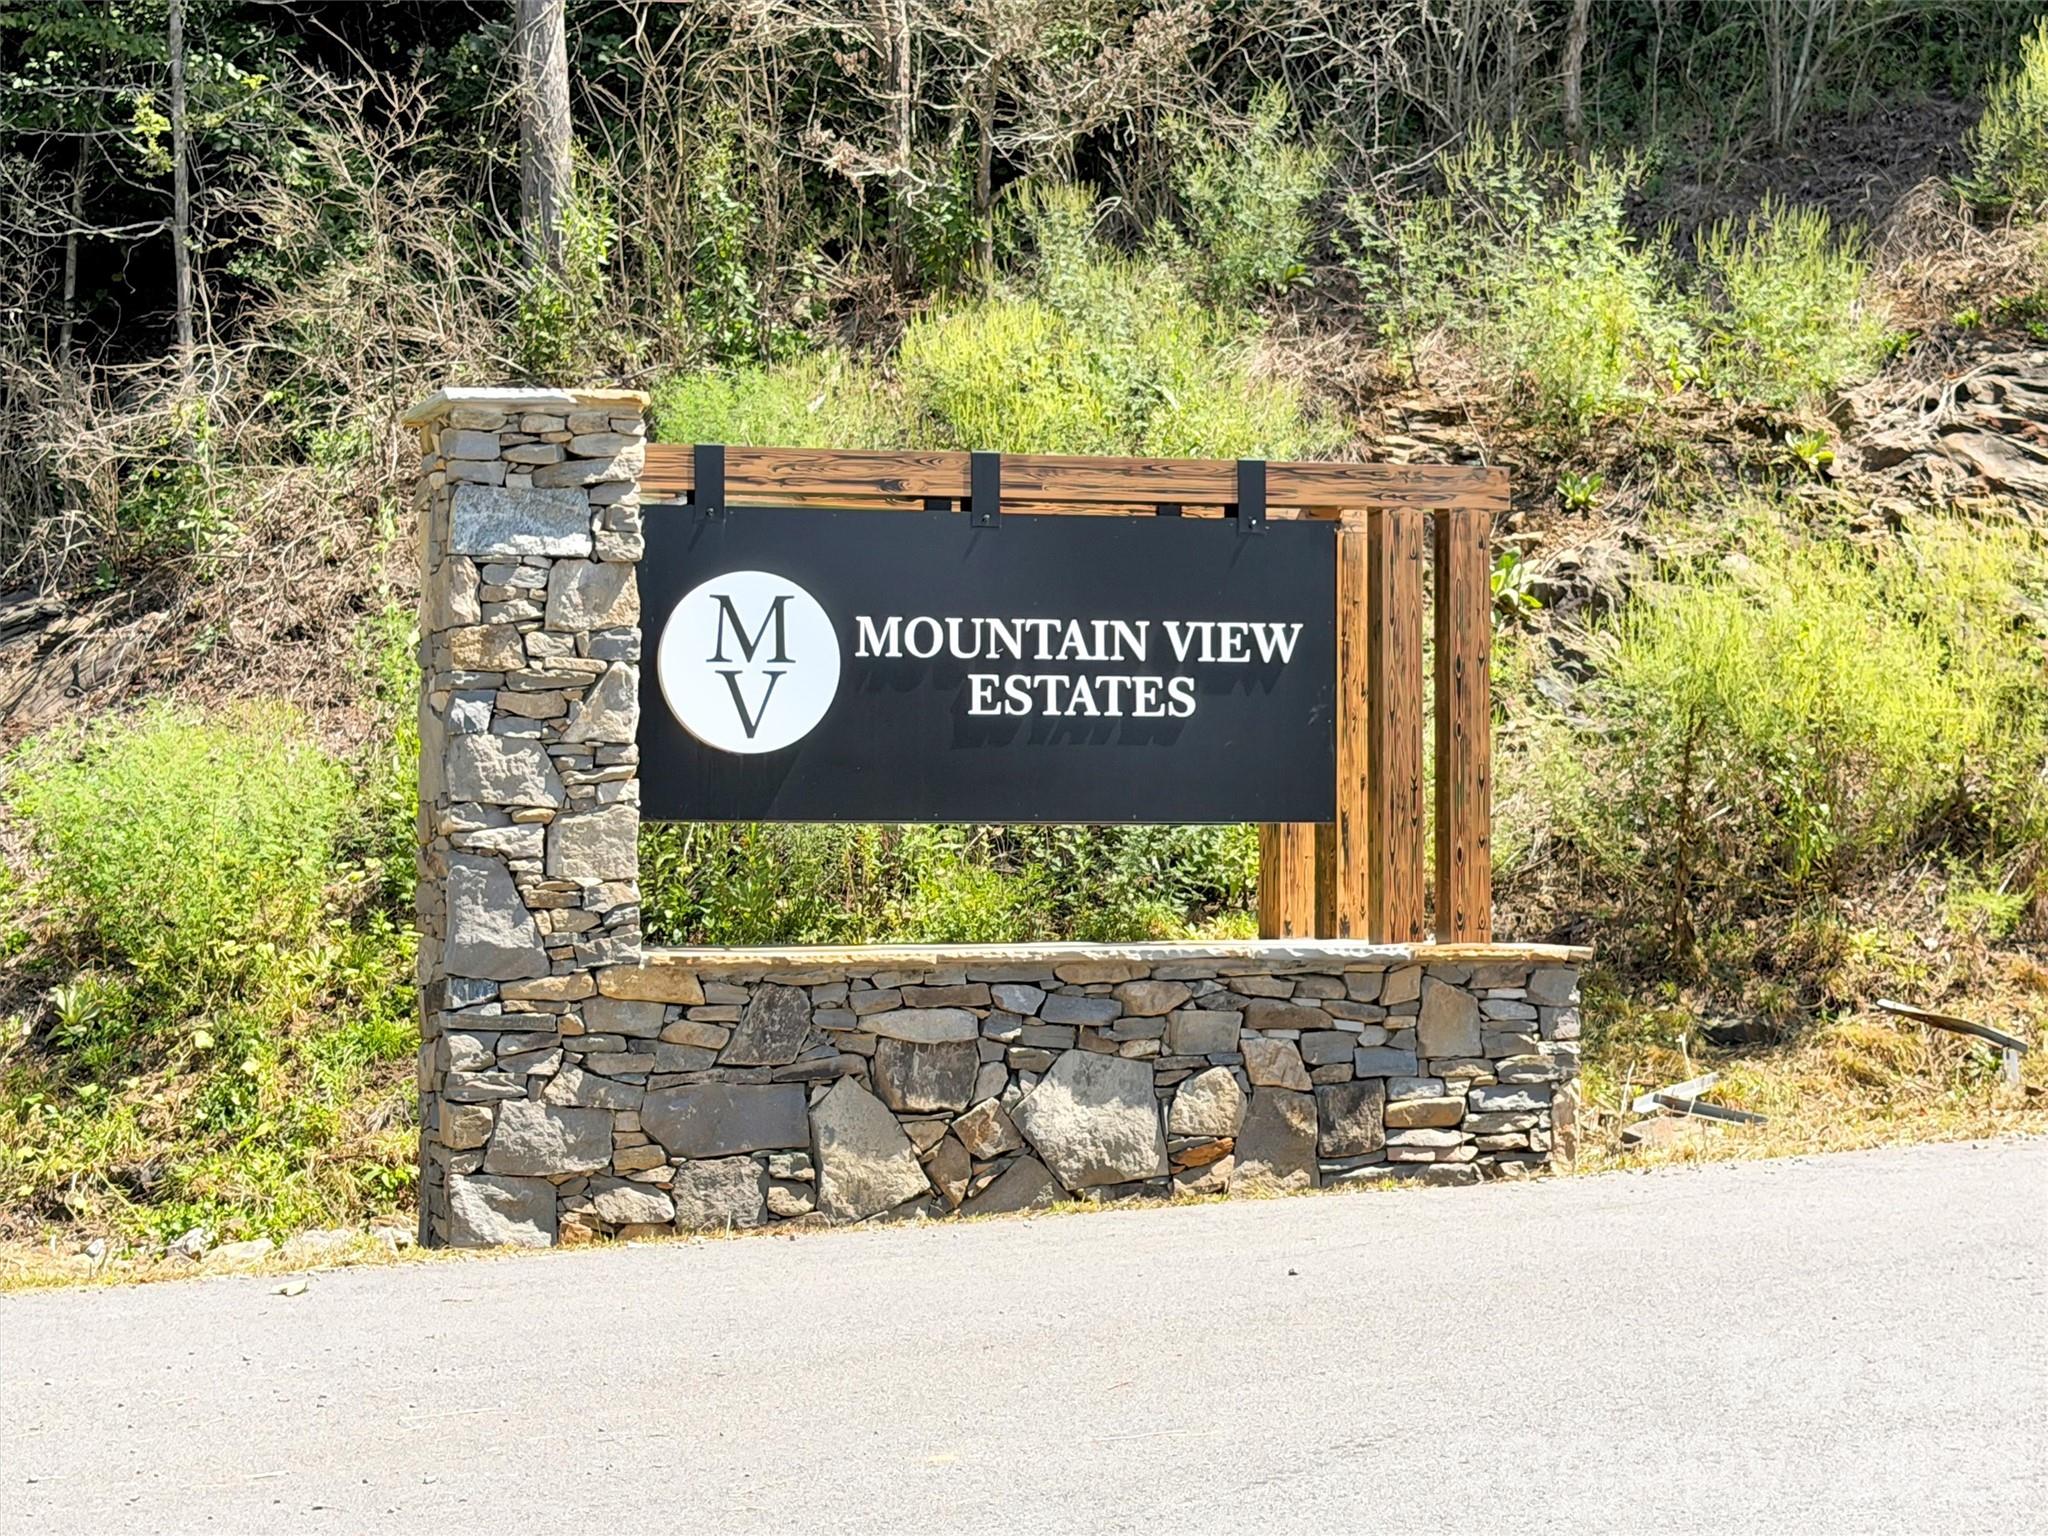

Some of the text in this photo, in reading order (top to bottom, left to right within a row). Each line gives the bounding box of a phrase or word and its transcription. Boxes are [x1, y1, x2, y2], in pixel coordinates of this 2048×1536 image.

[705, 593, 797, 664] M
[854, 615, 1304, 664] MOUNTAIN VIEW
[714, 669, 788, 739] V
[967, 673, 1197, 718] ESTATES
